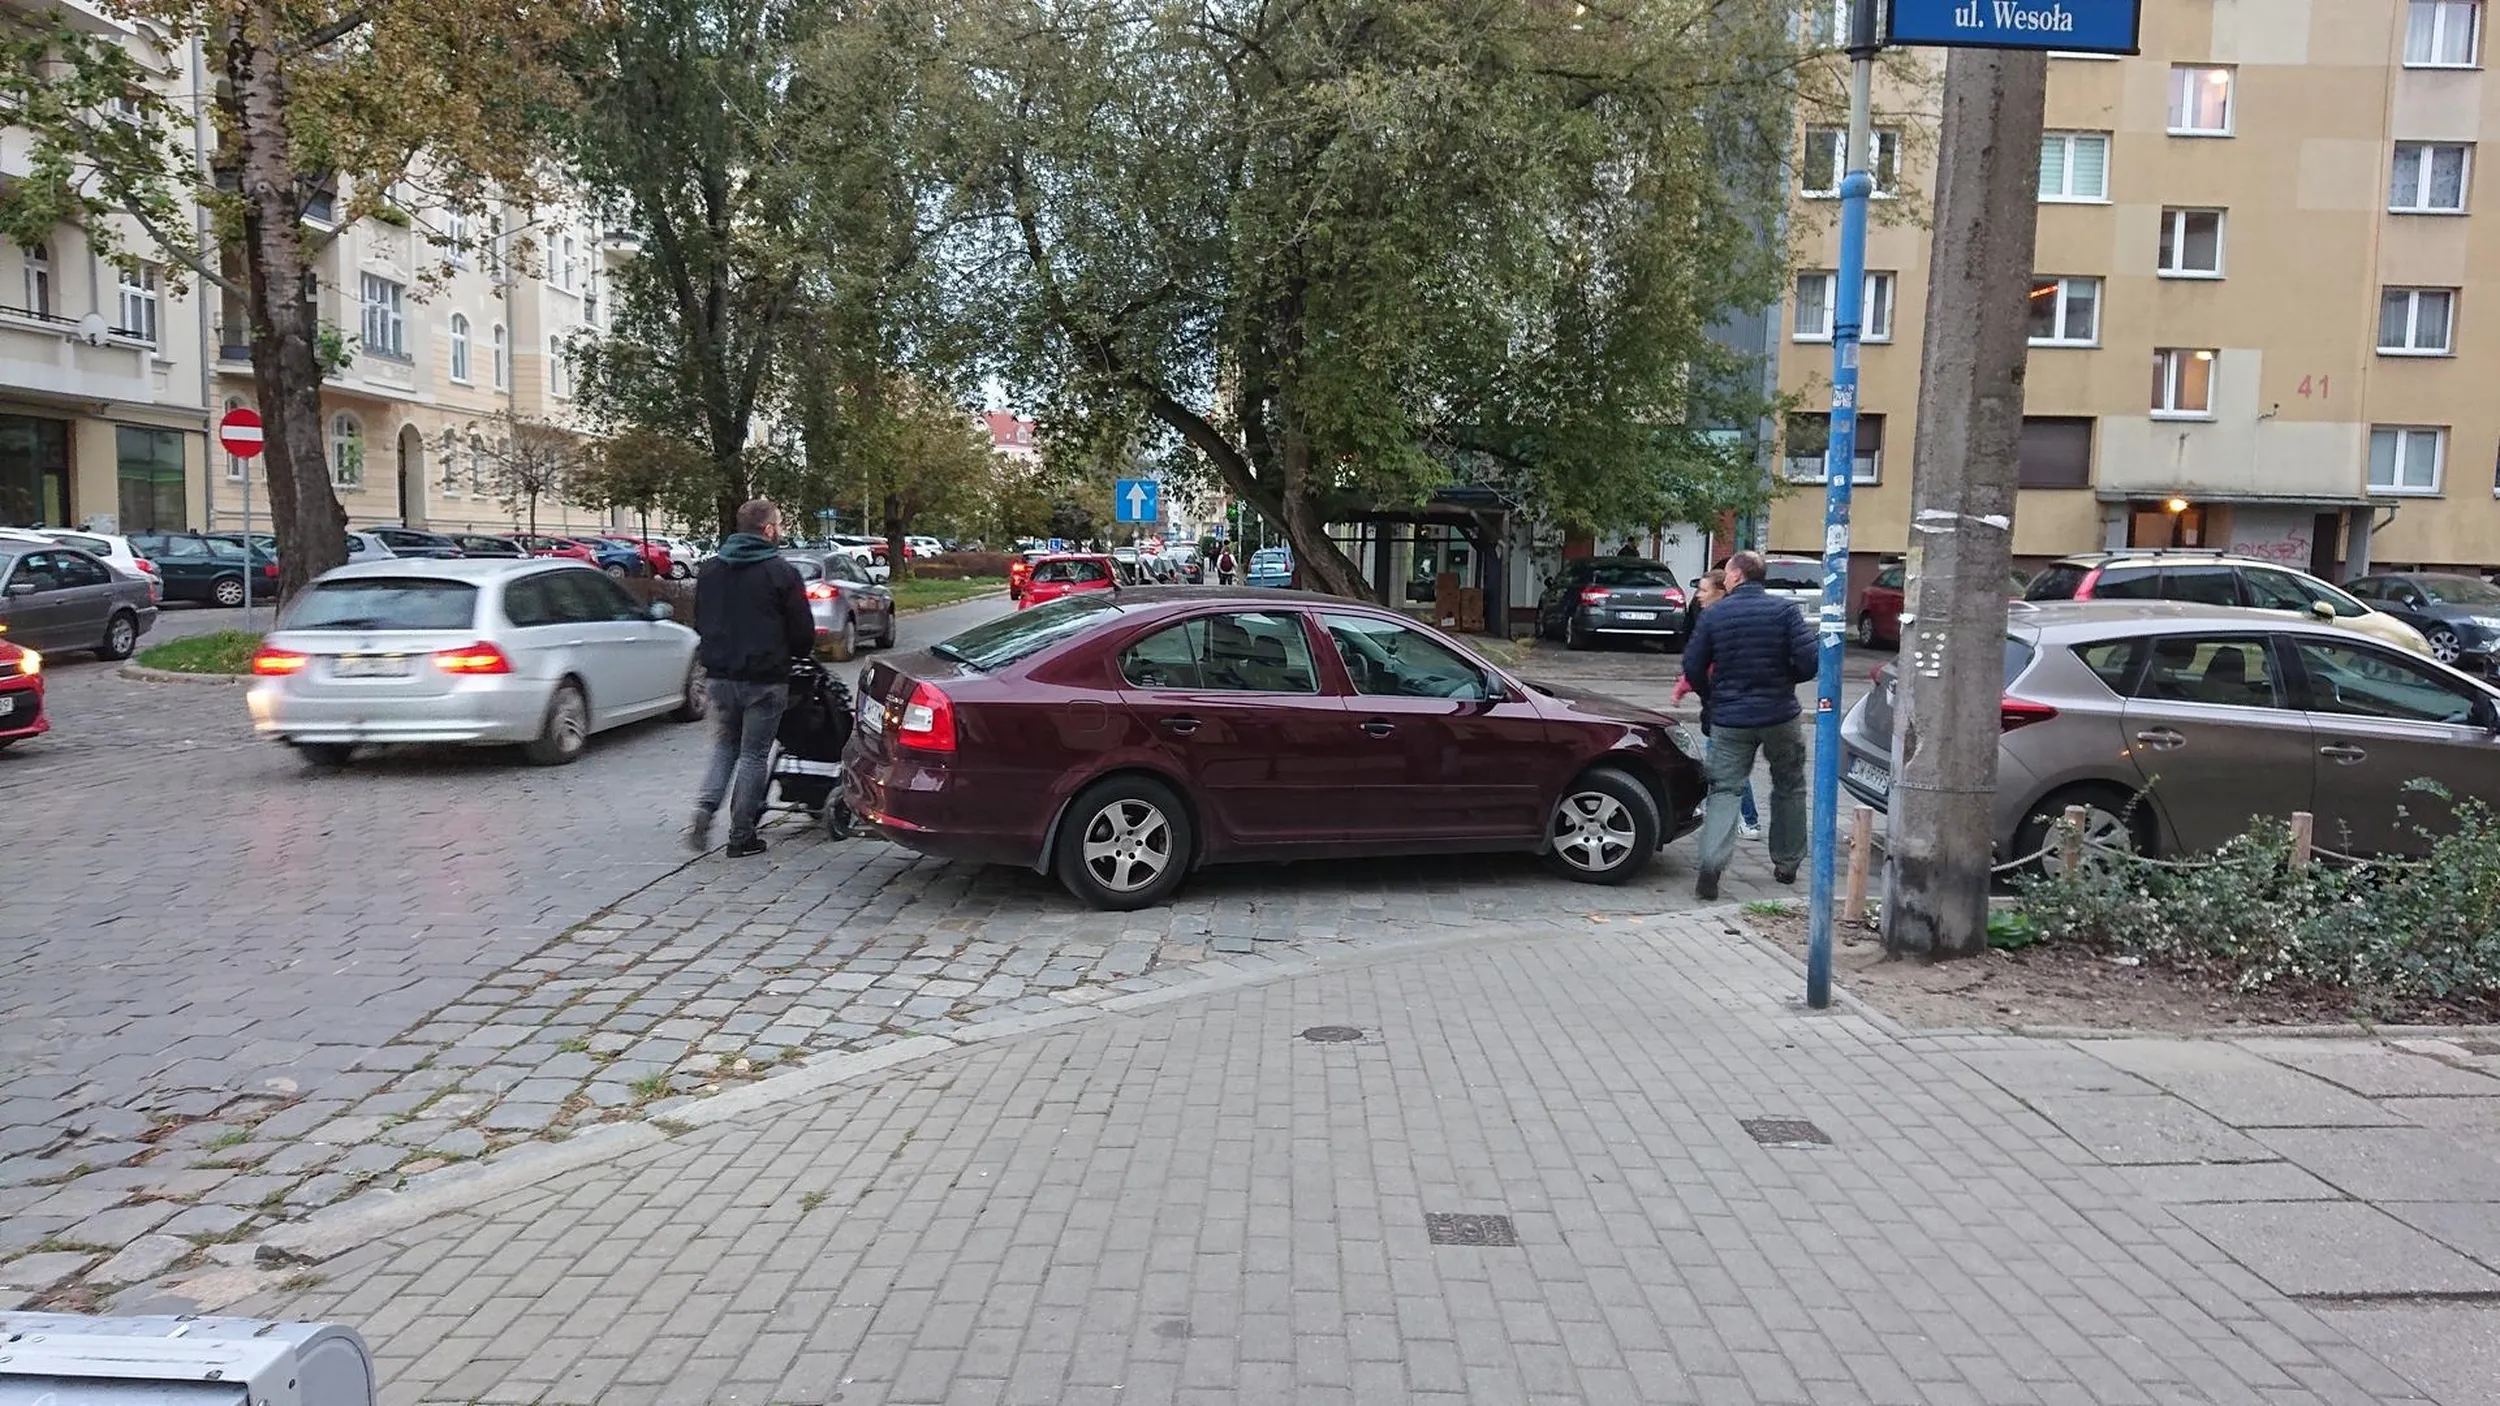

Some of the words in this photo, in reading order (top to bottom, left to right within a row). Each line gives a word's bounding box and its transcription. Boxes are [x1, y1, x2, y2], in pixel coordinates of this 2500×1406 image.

[1955, 0, 1984, 28] ul.
[1993, 1, 2073, 32] Wesoła
[2297, 374, 2329, 400] 41
